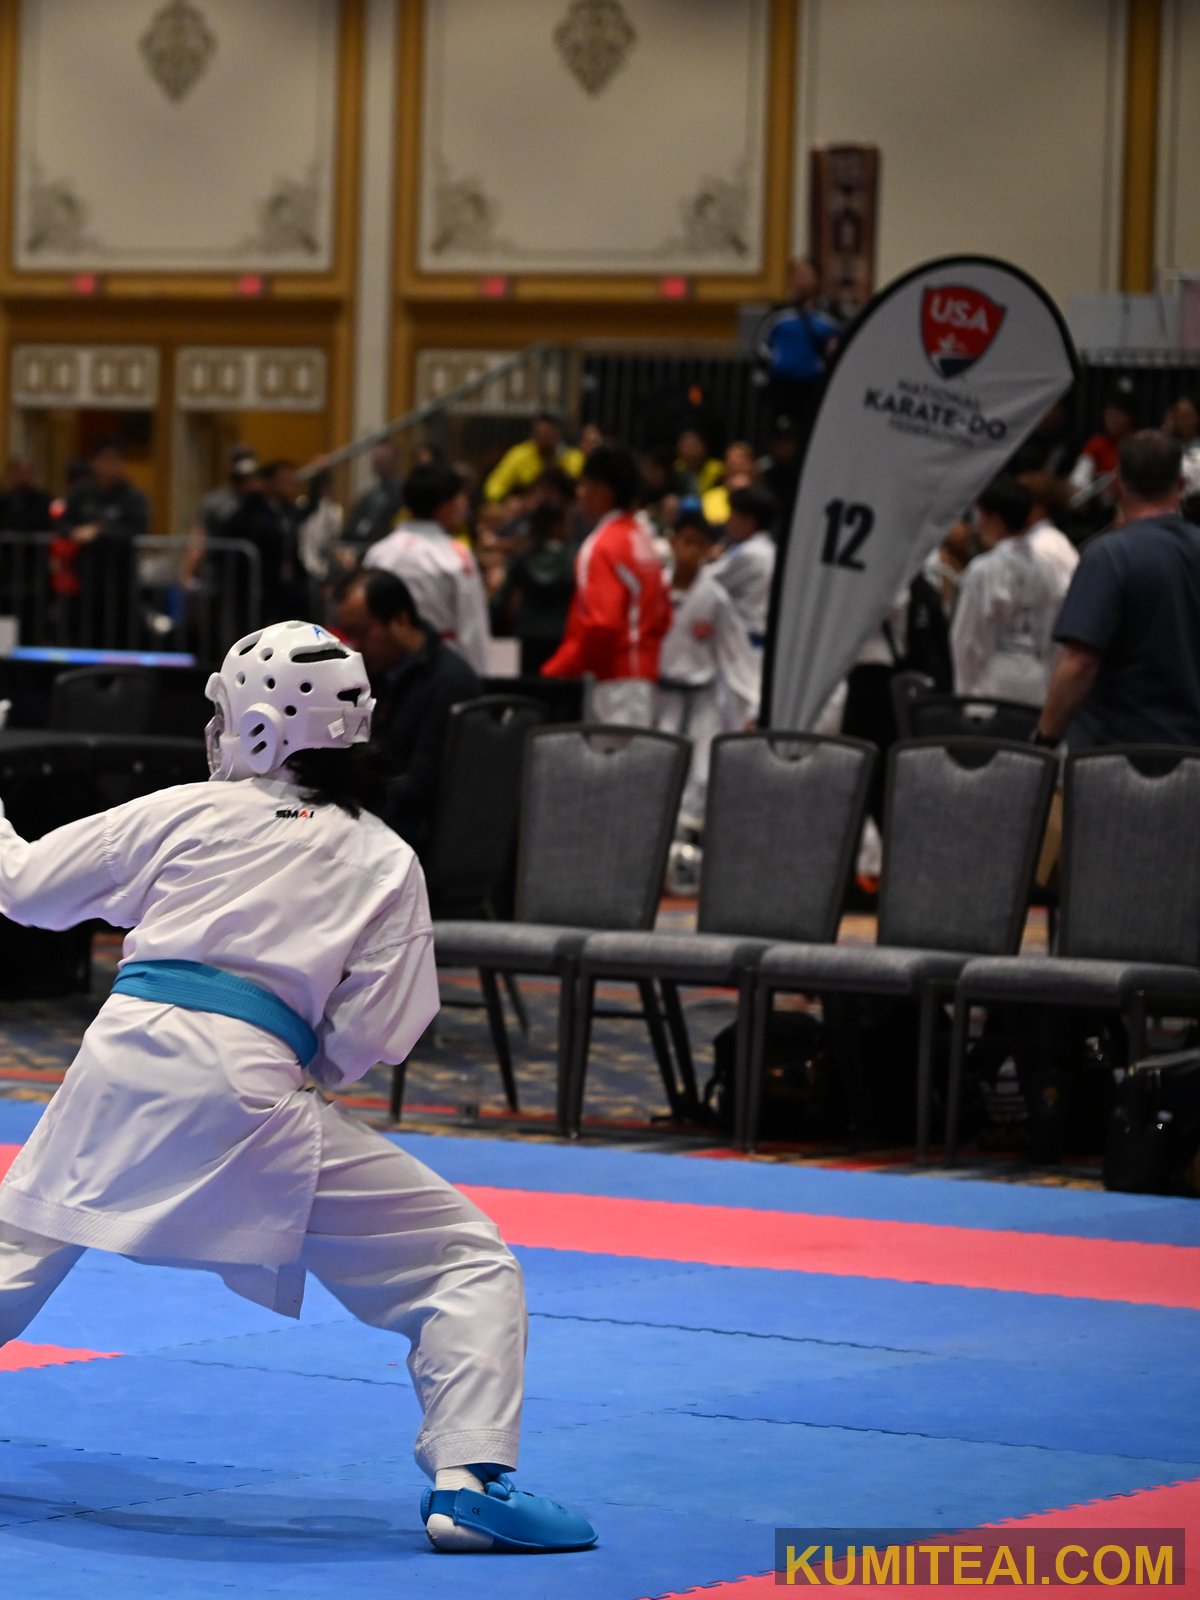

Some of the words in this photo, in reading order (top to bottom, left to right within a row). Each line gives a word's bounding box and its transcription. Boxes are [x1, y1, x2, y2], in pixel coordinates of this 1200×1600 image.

[930, 293, 990, 335] USA
[863, 387, 1008, 440] KARATE-DO
[821, 498, 875, 573] 12
[275, 809, 315, 819] SMAI
